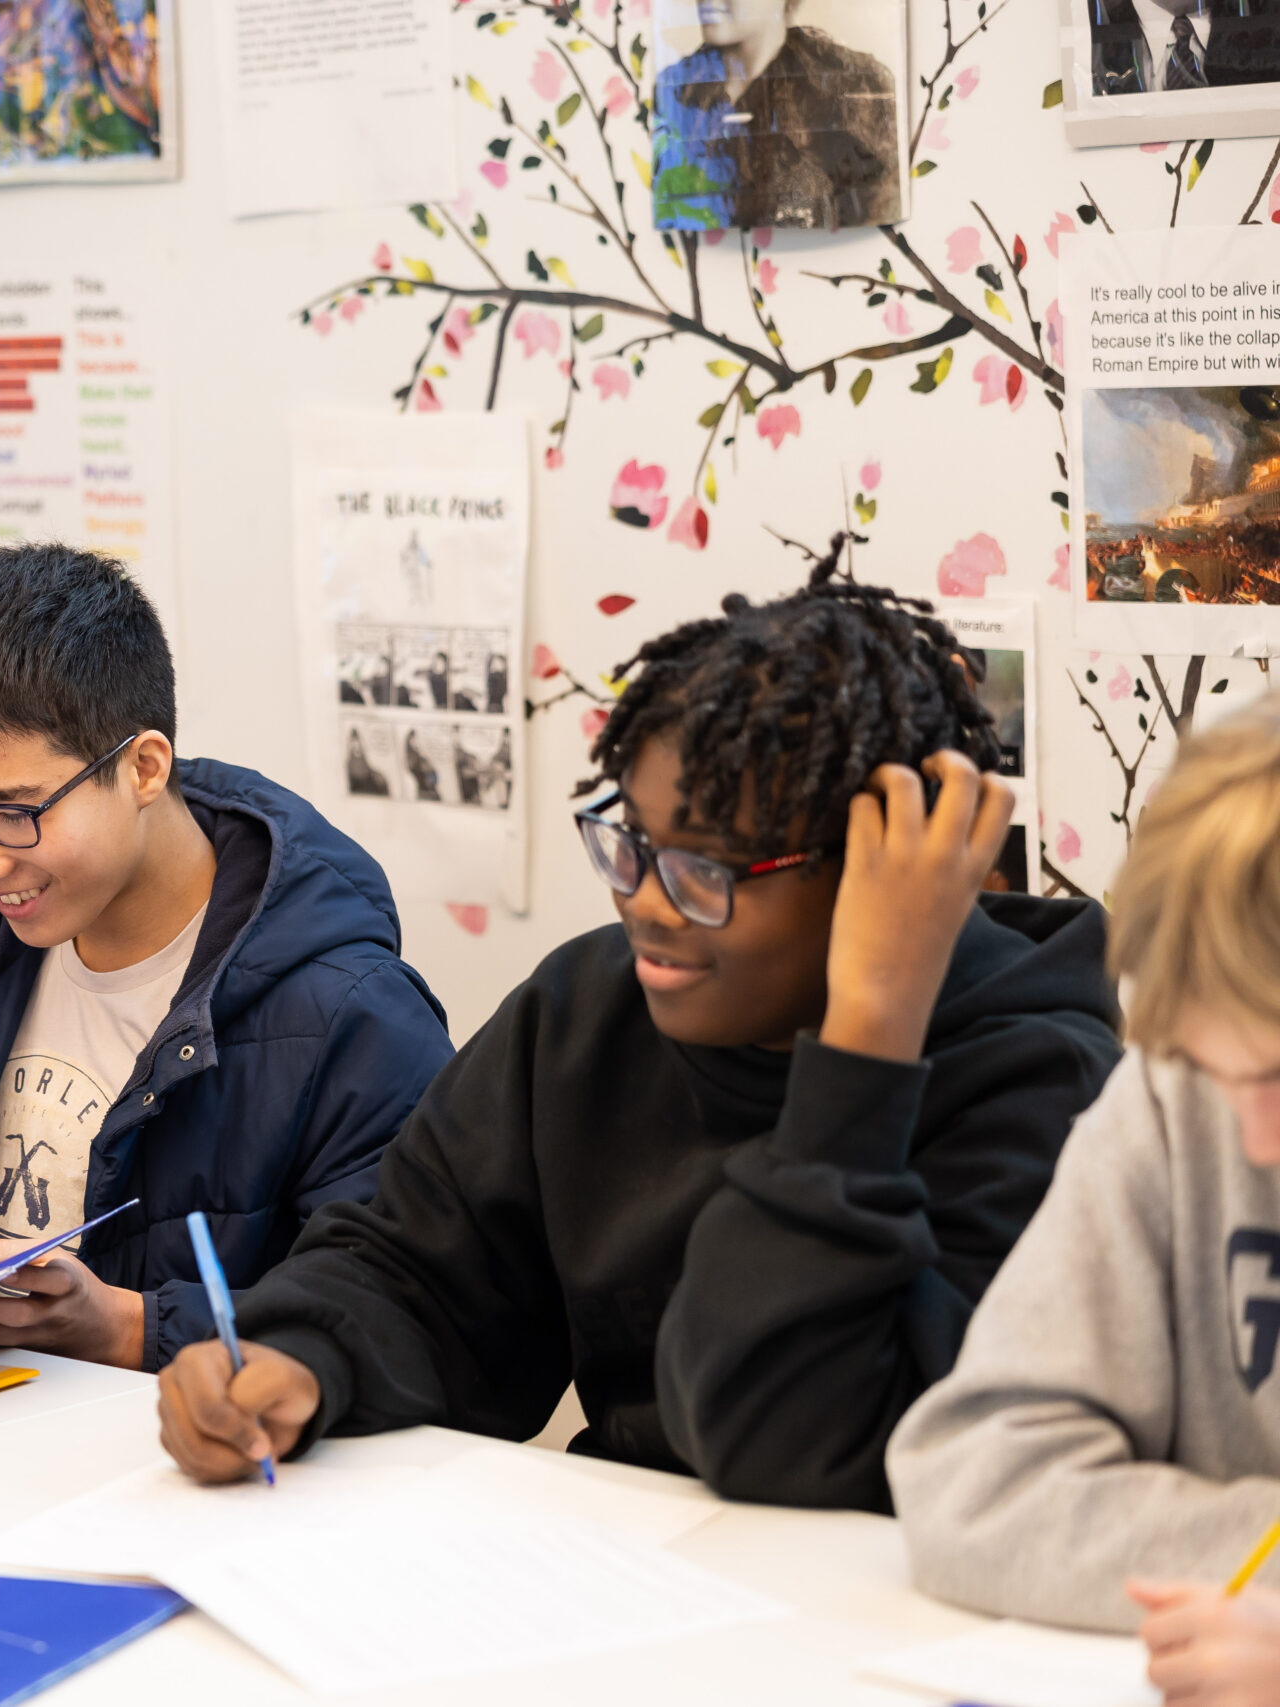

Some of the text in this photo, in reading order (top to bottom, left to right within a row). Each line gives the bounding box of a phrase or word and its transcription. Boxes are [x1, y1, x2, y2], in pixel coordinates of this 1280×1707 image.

[1090, 286, 1110, 301] It's
[1114, 285, 1153, 304] really
[1157, 283, 1187, 301] cool
[1191, 283, 1205, 298] to
[1210, 282, 1228, 298] be
[1233, 281, 1267, 297] alive
[1091, 309, 1149, 325] America
[1154, 309, 1168, 323] at
[1172, 307, 1197, 323] this
[1202, 306, 1238, 324] point
[1242, 305, 1255, 321] in
[1092, 329, 1280, 350] because it's like the collap
[1092, 357, 1143, 373] Roman
[1148, 356, 1199, 374] Empire
[1204, 355, 1227, 370] but
[1231, 354, 1261, 370] with
[336, 491, 505, 522] THE BLACK PRINCE
